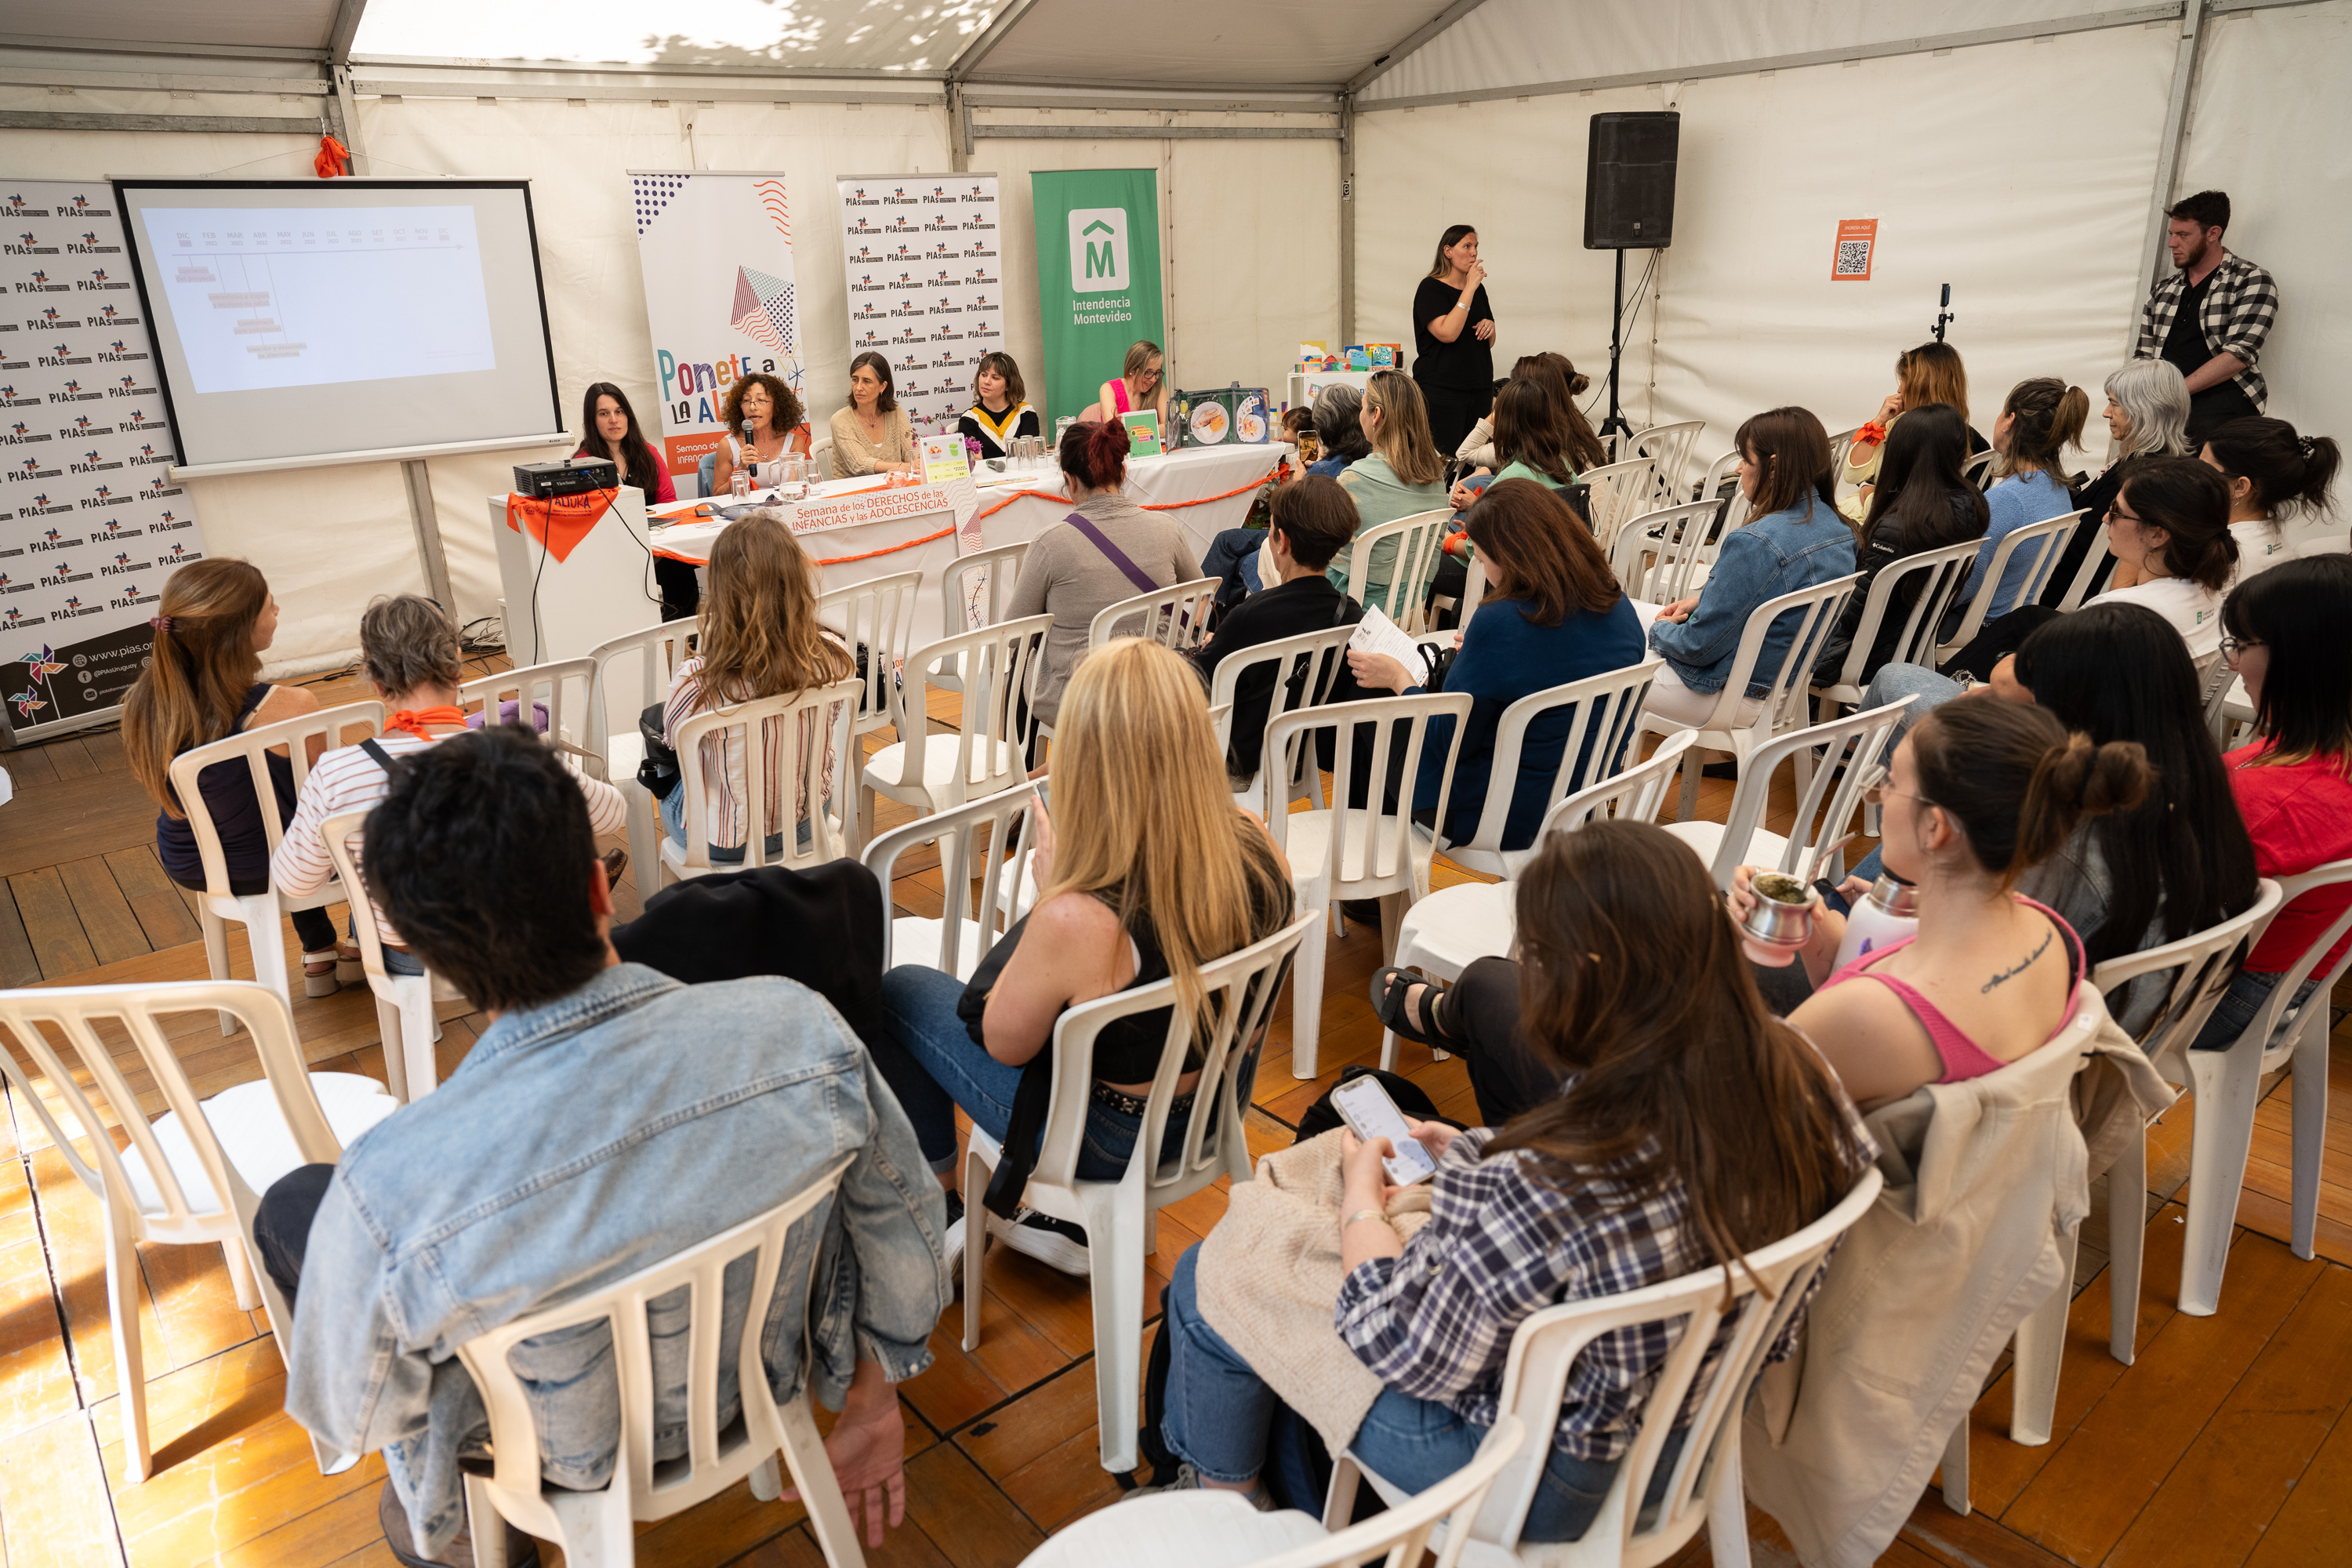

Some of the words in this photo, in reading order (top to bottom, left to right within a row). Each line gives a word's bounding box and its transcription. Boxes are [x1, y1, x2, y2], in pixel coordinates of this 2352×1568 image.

[0, 205, 20, 216] IAs
[57, 205, 83, 216] PIAs
[3, 244, 32, 255] PIAs
[67, 243, 93, 254] PIAs
[16, 282, 43, 292] PIAs
[77, 280, 103, 290] PIAs
[1073, 296, 1131, 311] Intendencia
[87, 317, 112, 326] PIAs
[1074, 310, 1131, 325] Montevideo
[27, 319, 54, 330] PIAs
[38, 356, 65, 367] PIAs
[98, 353, 122, 362] PIAs
[108, 387, 130, 397] PIAs
[0, 397, 12, 408] As
[49, 393, 75, 403] PIAs
[672, 401, 691, 424] LA
[119, 422, 140, 432] PIAs
[60, 428, 86, 439] PIAs
[677, 444, 707, 452] Semana
[129, 456, 151, 466] PIAs
[70, 463, 96, 474] PIAs
[8, 471, 34, 482] PIAs
[140, 491, 161, 500] PIAs
[81, 498, 106, 509] PIAs
[555, 495, 590, 509] ALTURA
[797, 505, 837, 519] Semana
[840, 503, 851, 512] de
[852, 502, 864, 510] los
[866, 493, 919, 508] DERECHOS
[933, 489, 944, 498] las
[19, 507, 45, 517] PIAs
[792, 514, 848, 531] INFANCIAS
[856, 512, 868, 521] las
[869, 499, 949, 519] ADOLESCENCIAS
[149, 524, 171, 533] PIAs
[91, 532, 115, 543] PIAs
[30, 543, 56, 553] PIAs
[1876, 543, 1894, 553] Columbia
[158, 556, 181, 566] PIAs
[100, 565, 125, 576] PIAs
[40, 576, 66, 587] PIAs
[111, 599, 135, 609] PIAs
[51, 610, 77, 621] PIAs
[0, 621, 16, 632] As
[94, 662, 137, 677] @PIAsUruguay
